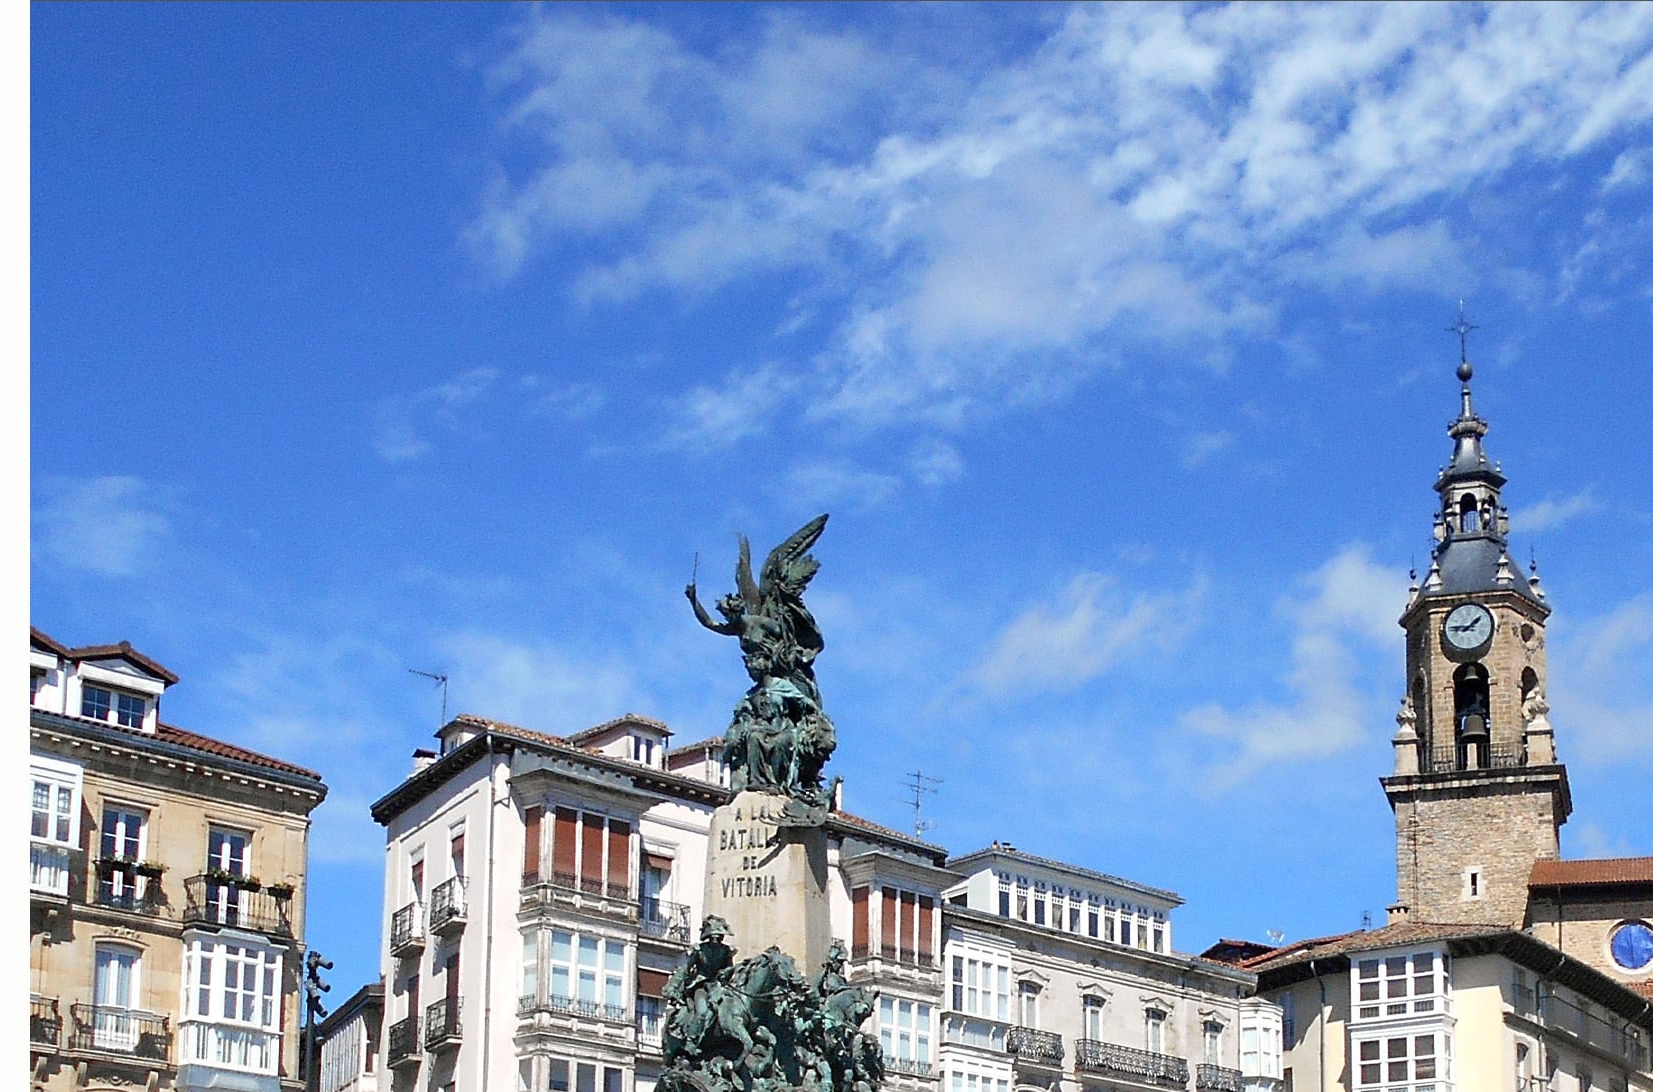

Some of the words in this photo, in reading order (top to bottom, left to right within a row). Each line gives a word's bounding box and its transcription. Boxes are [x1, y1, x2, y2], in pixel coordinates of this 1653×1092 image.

[735, 807, 743, 822] A
[720, 827, 769, 850] BATALL
[743, 856, 757, 870] DE
[722, 875, 777, 898] VITORIA
